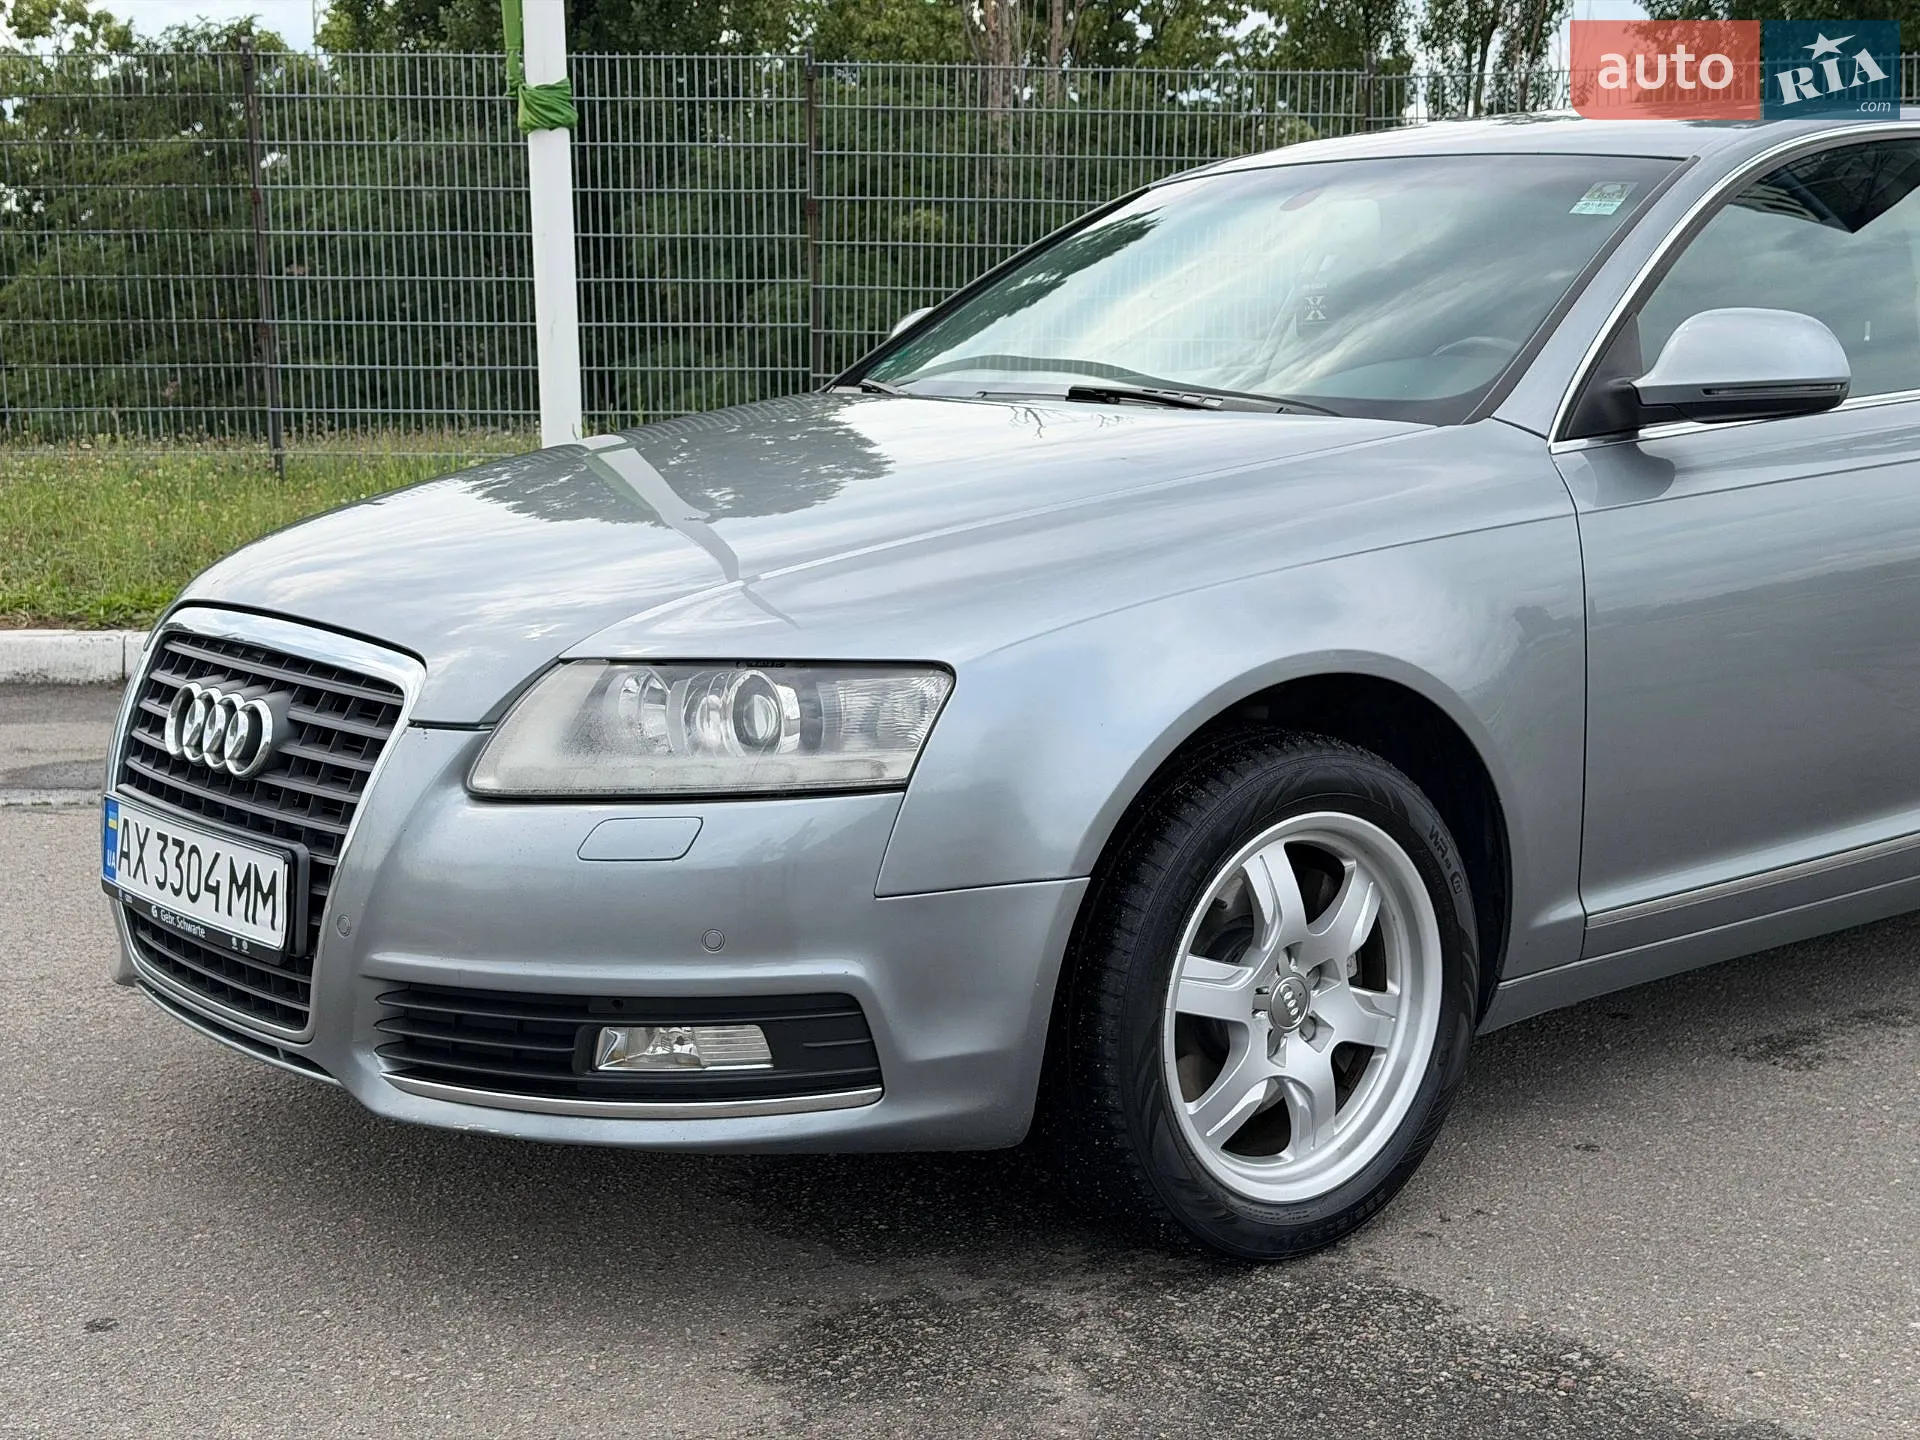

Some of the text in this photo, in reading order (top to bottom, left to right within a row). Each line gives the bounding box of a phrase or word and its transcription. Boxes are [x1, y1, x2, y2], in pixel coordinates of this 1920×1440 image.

[107, 849, 116, 868] UA
[118, 818, 278, 931] AX 3304 MM
